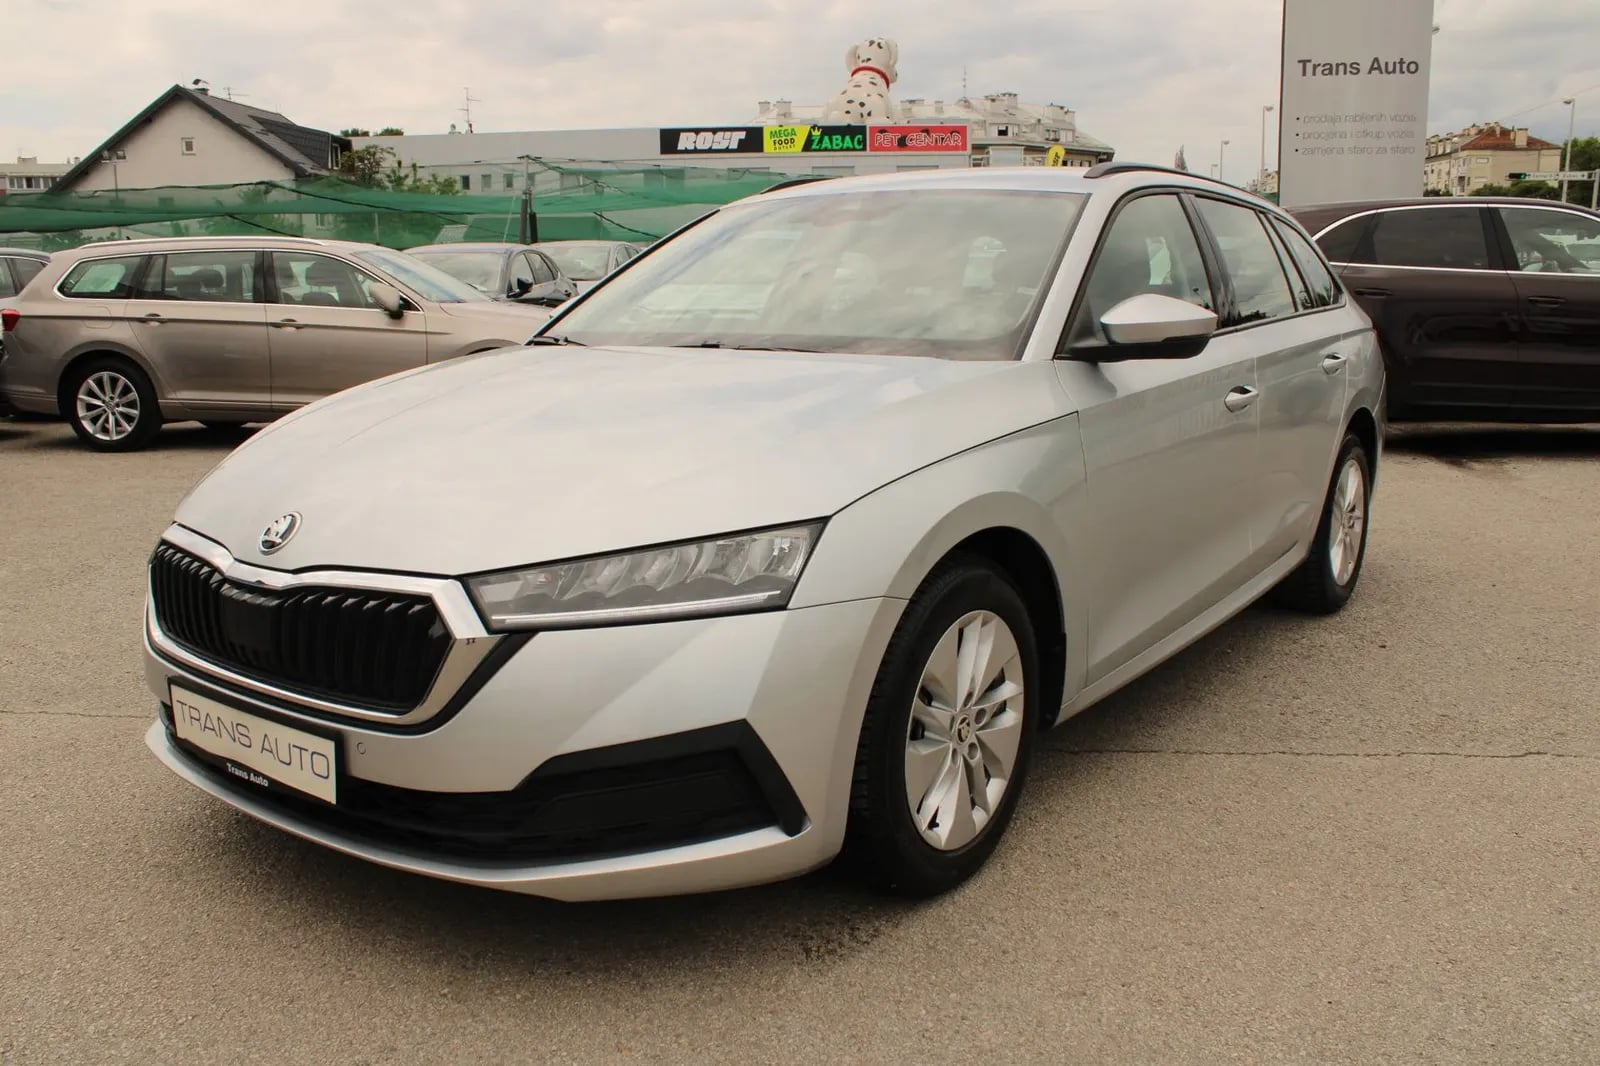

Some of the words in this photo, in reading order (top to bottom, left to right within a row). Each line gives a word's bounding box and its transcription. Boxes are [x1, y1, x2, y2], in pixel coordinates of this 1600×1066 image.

[1297, 59, 1361, 77] Trans
[1367, 56, 1420, 75] Auto
[769, 128, 797, 139] MEGA
[773, 137, 796, 146] FOOD
[875, 132, 901, 147] PET
[905, 132, 962, 146] CENTAR
[176, 700, 252, 749] TRANS
[260, 733, 330, 780] AUTO
[226, 762, 249, 780] Trans
[249, 772, 269, 787] Auto
